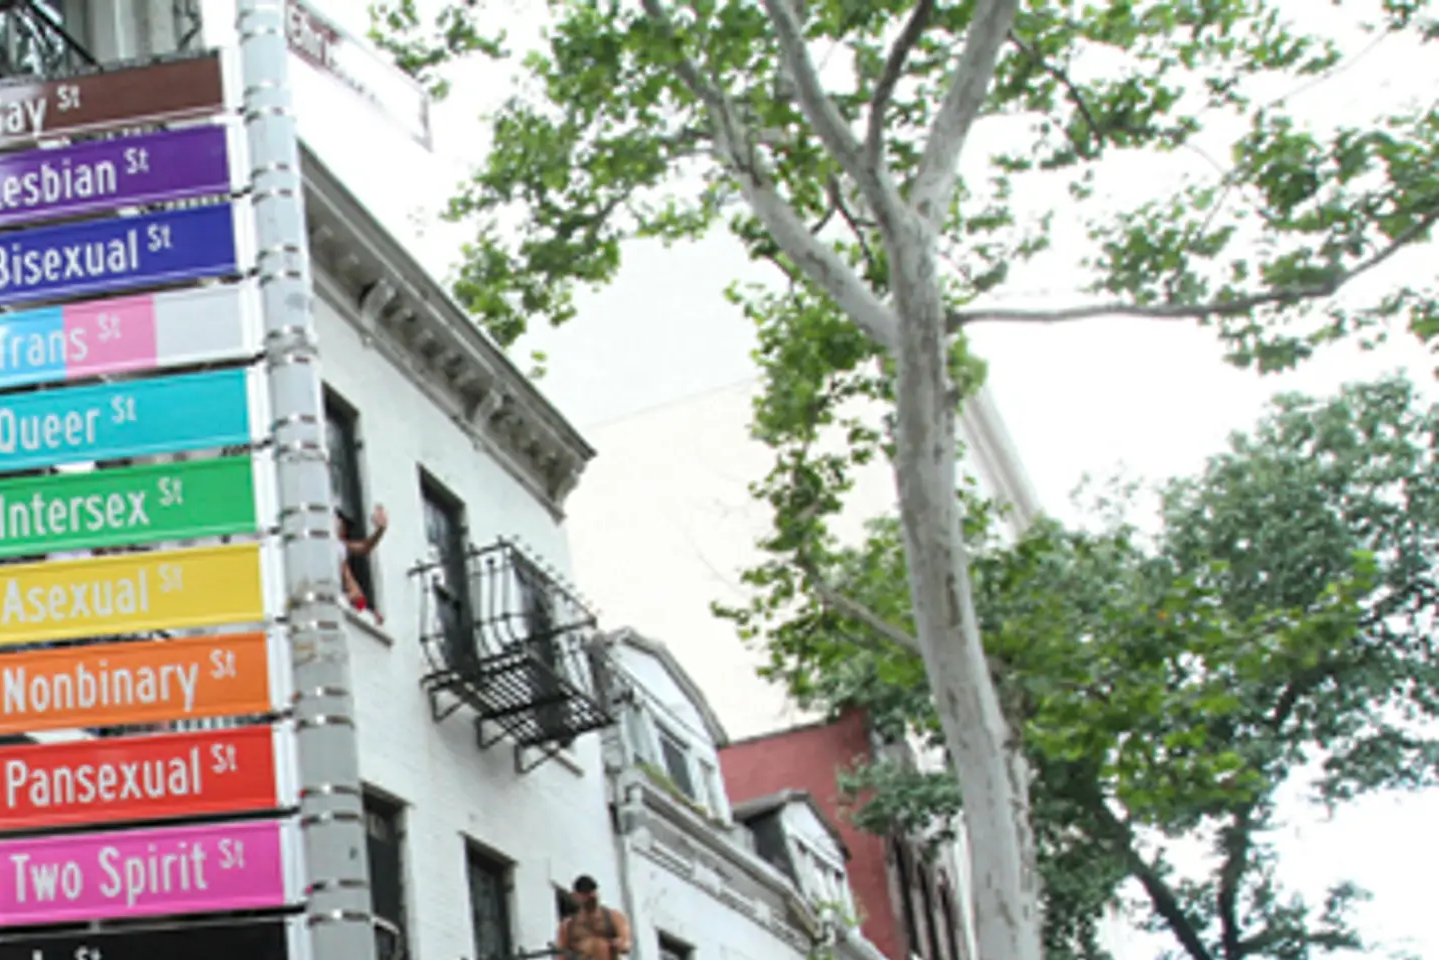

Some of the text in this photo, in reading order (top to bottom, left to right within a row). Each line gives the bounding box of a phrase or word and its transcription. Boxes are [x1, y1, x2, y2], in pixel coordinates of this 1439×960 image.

[57, 85, 81, 110] St
[124, 147, 149, 174] St
[147, 223, 173, 252] St
[97, 313, 122, 342] St
[112, 396, 137, 423] St
[157, 477, 184, 505] St
[0, 563, 184, 626] Asexual St
[2, 649, 237, 715] Nonbinary St
[5, 744, 237, 809] Pansexual St
[11, 838, 245, 909] Two Spirit St
